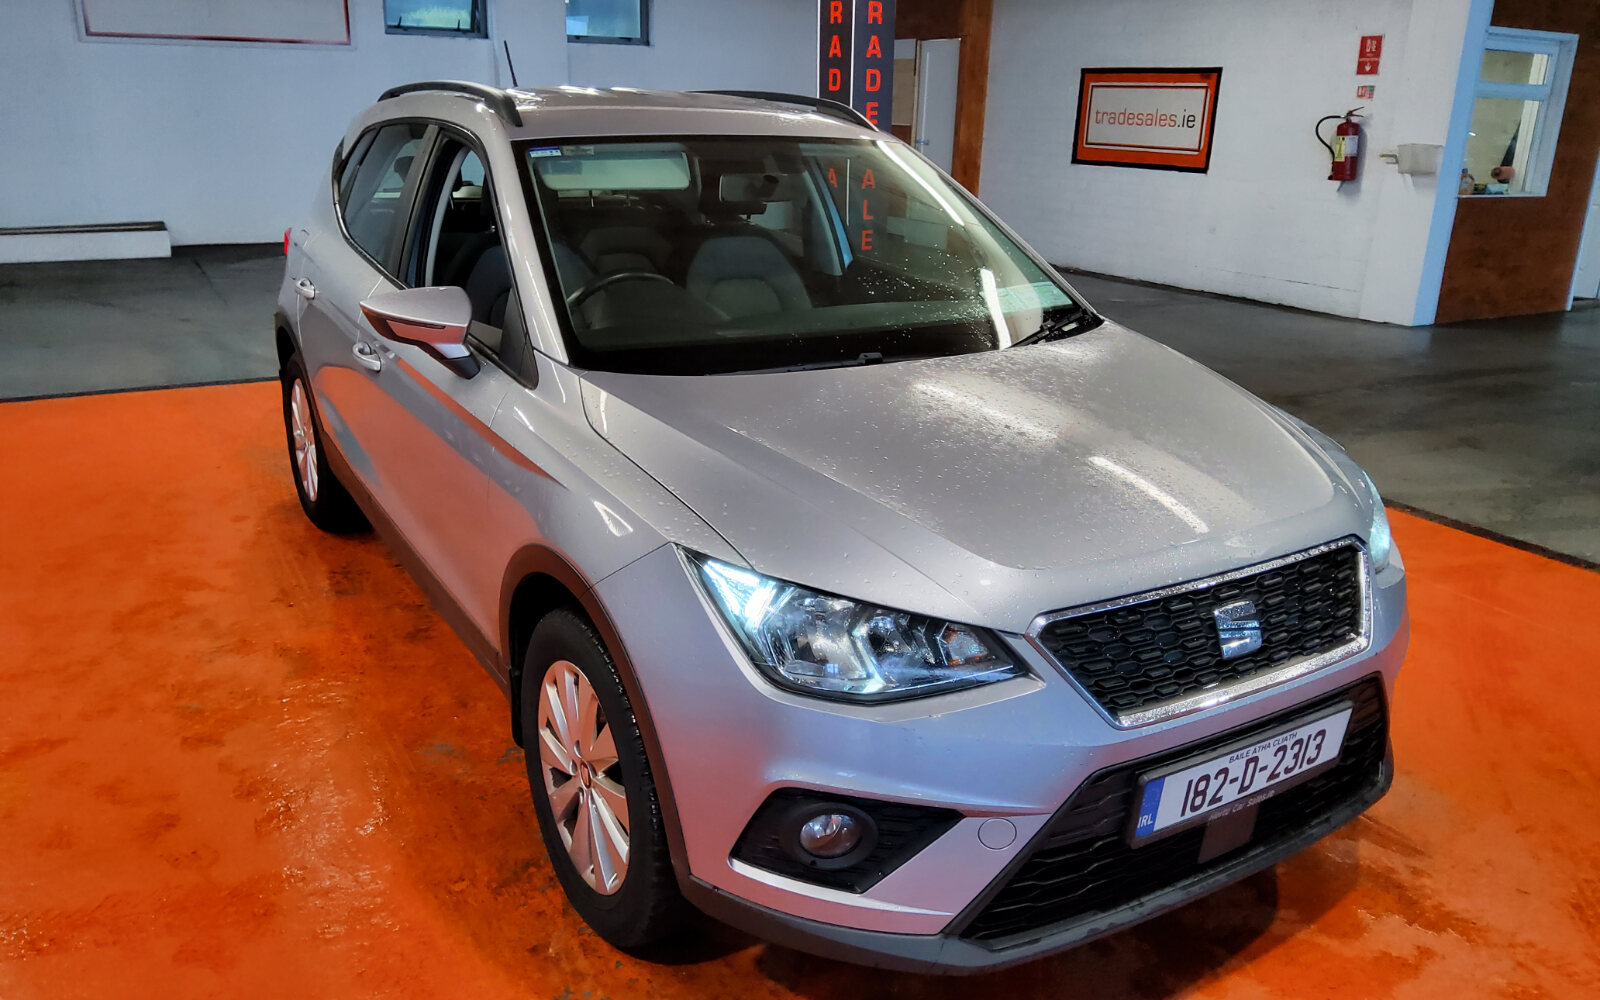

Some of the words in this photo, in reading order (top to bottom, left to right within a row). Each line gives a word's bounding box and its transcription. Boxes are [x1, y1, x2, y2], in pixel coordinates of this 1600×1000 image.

[1095, 107, 1197, 129] tradesales.ie
[1229, 749, 1251, 764] BAILE
[1272, 732, 1298, 747] CLIATH
[1180, 728, 1327, 818] 182-D-2313
[1137, 813, 1154, 829] IRL
